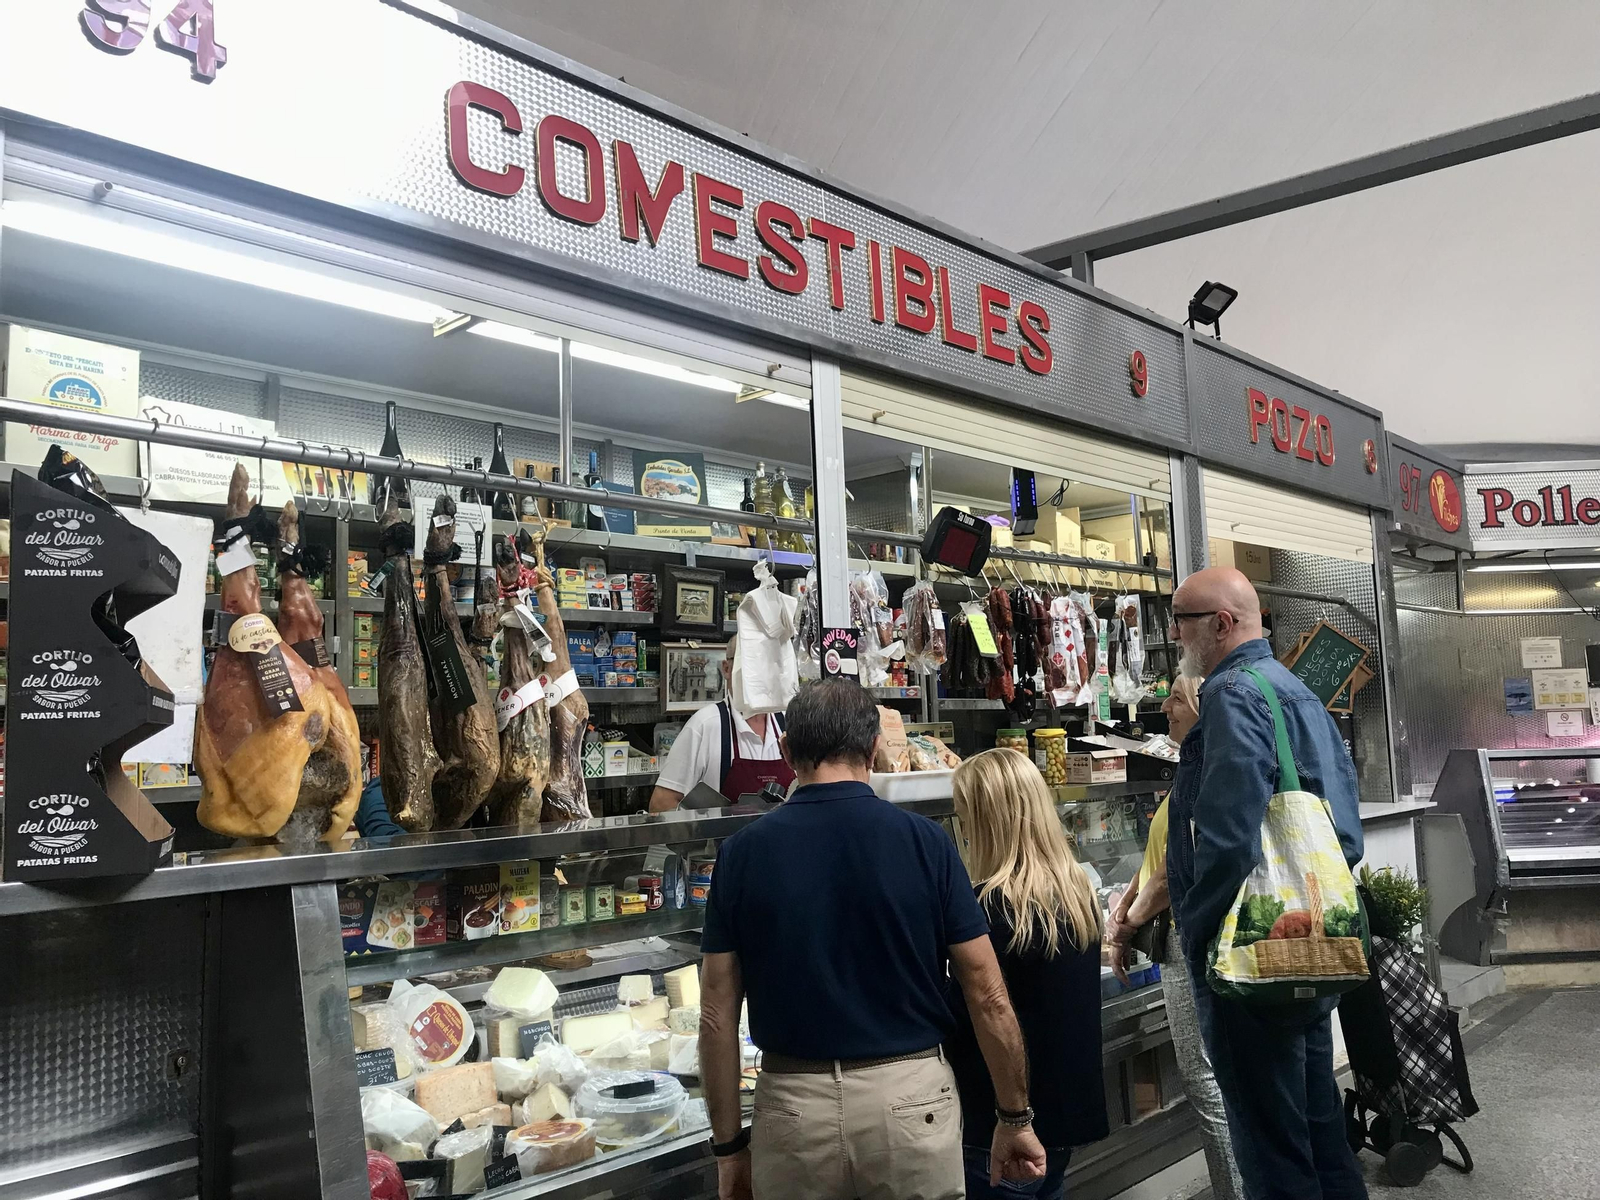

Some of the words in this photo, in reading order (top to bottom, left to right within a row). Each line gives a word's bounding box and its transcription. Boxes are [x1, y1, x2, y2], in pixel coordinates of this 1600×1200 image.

[445, 80, 1054, 376] COMESTIBLES
[1128, 349, 1150, 398] 9
[1247, 386, 1335, 467] POZO
[28, 423, 72, 440] Harina
[73, 430, 88, 441] de
[89, 432, 119, 452] Trigo
[1364, 438, 1378, 474] 6
[168, 466, 190, 476] QUESOS
[1399, 461, 1421, 515] 97
[1477, 484, 1600, 529] Polle
[36, 508, 96, 523] CORTIJO
[25, 532, 51, 546] del
[54, 530, 104, 546] Olivar
[36, 552, 59, 568] SABOR
[61, 560, 65, 568] A
[67, 552, 94, 568] PUEBLO
[24, 569, 68, 577] PATATAS
[822, 629, 857, 649] NOVEDAD
[32, 650, 93, 664] CORTIJO
[258, 661, 282, 671] SERRANO
[264, 667, 280, 675] GRAN
[21, 674, 48, 688] del
[51, 672, 102, 688] Olivar
[262, 671, 286, 680] RESERVA
[441, 660, 458, 699] MONTARAZ
[32, 694, 56, 710] SABOR
[64, 694, 91, 709] PUEBLO
[20, 711, 64, 720] PATATAS
[67, 710, 100, 719] FRITAS
[28, 794, 90, 810] CORTIJO
[18, 819, 44, 834] del
[47, 816, 99, 833] Olivar
[29, 840, 52, 855] SABOR
[61, 838, 88, 854] PUEBLO
[17, 858, 61, 867] PATATAS
[64, 856, 98, 865] FRITAS
[463, 882, 499, 895] PALADIN
